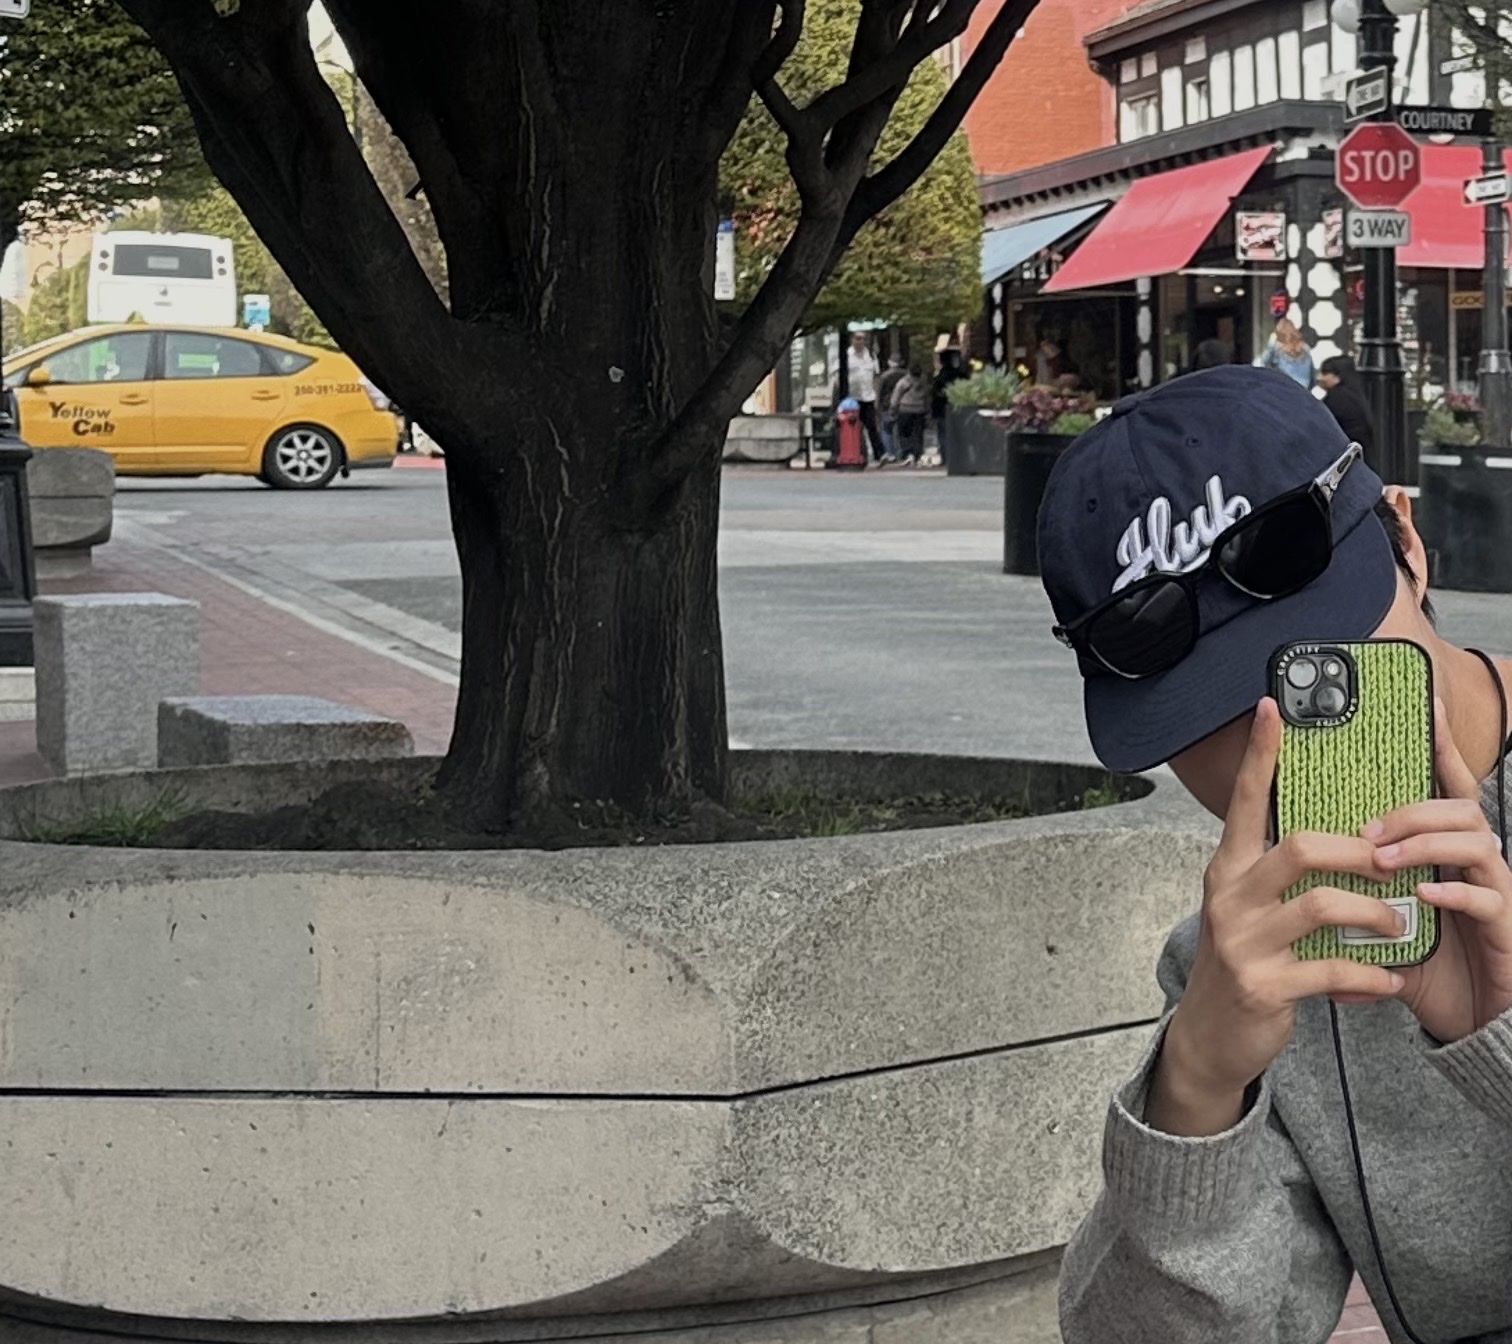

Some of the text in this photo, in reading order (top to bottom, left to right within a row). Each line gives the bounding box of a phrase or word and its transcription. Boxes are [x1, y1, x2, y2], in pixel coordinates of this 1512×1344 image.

[1400, 110, 1475, 131] COURTNEY
[1344, 150, 1415, 183] STOP
[1352, 218, 1407, 239] 3 WAY
[49, 401, 112, 420] Yellow
[72, 418, 116, 436] Cab
